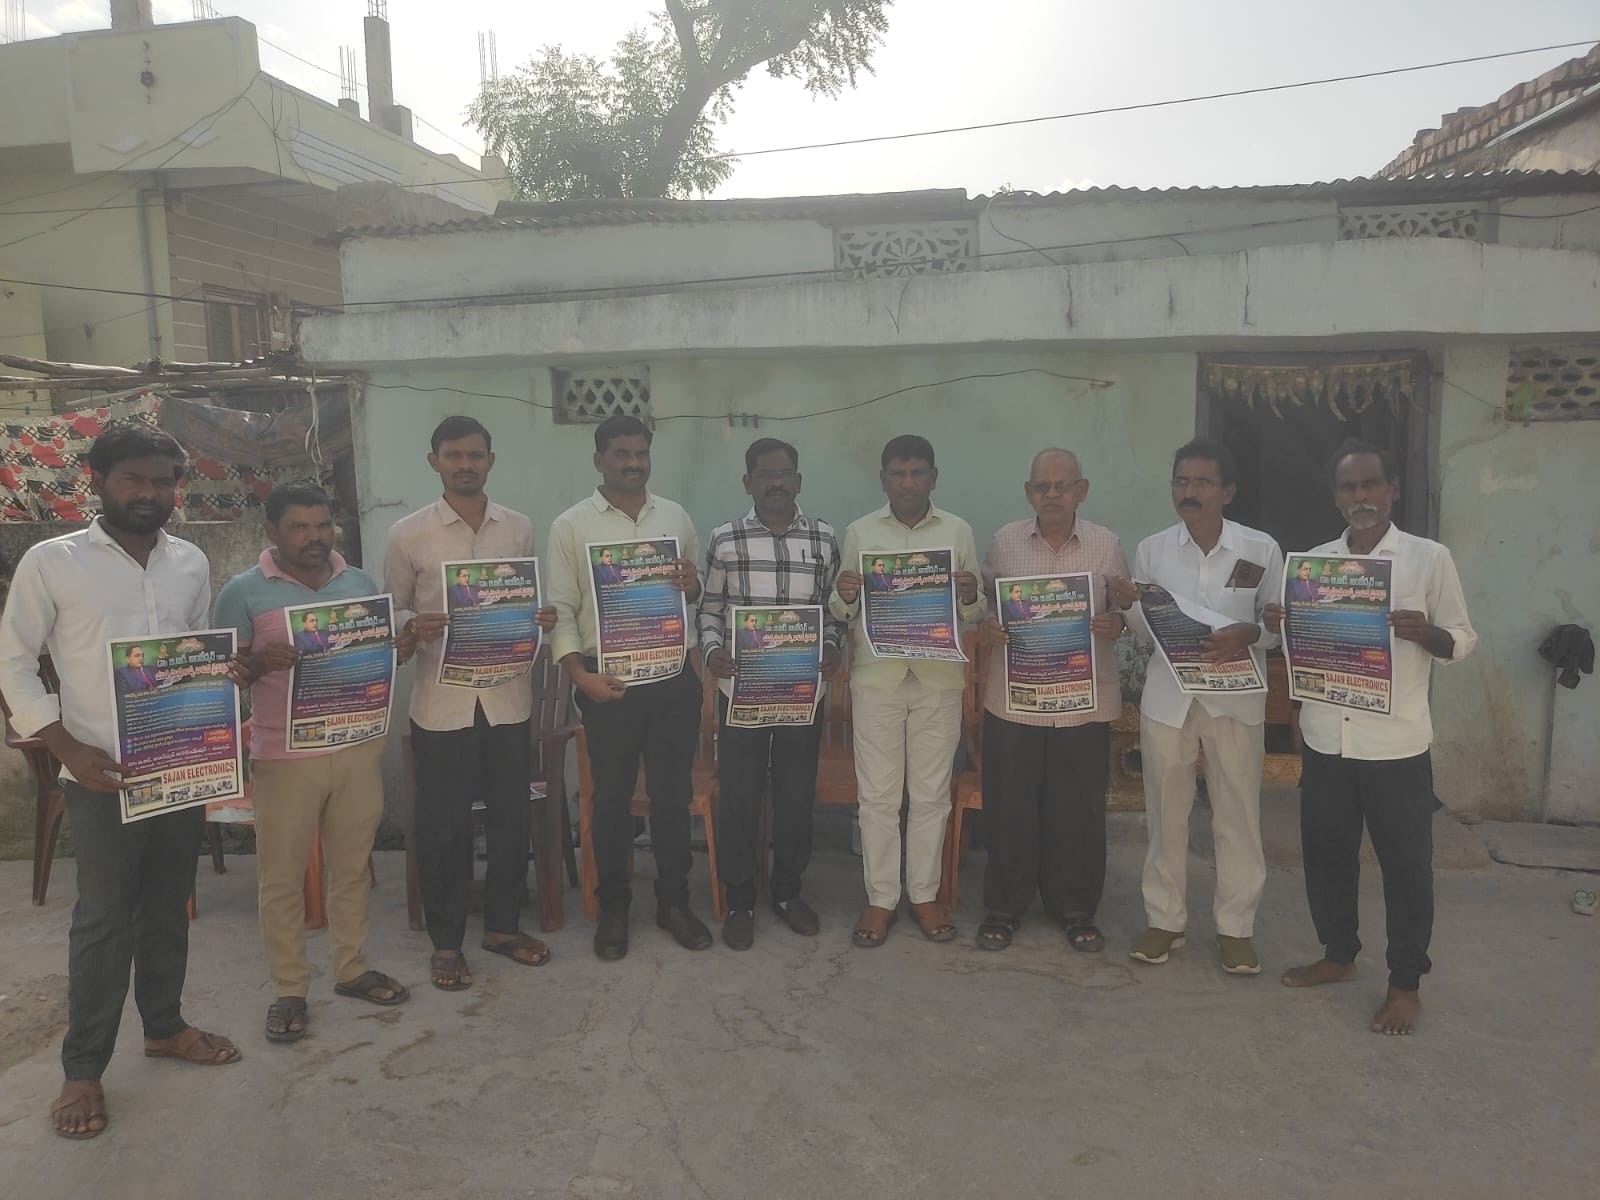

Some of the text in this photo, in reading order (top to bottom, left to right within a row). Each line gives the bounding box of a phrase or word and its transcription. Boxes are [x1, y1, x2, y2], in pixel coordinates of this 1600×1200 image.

[1325, 672, 1345, 685] SAJAN
[1346, 674, 1389, 692] ELECTRONICS
[326, 715, 346, 727] SAJAN
[347, 710, 385, 724] ELECTRONICS
[162, 770, 186, 785] SAJAN
[187, 761, 235, 780] ELECTRONICS
